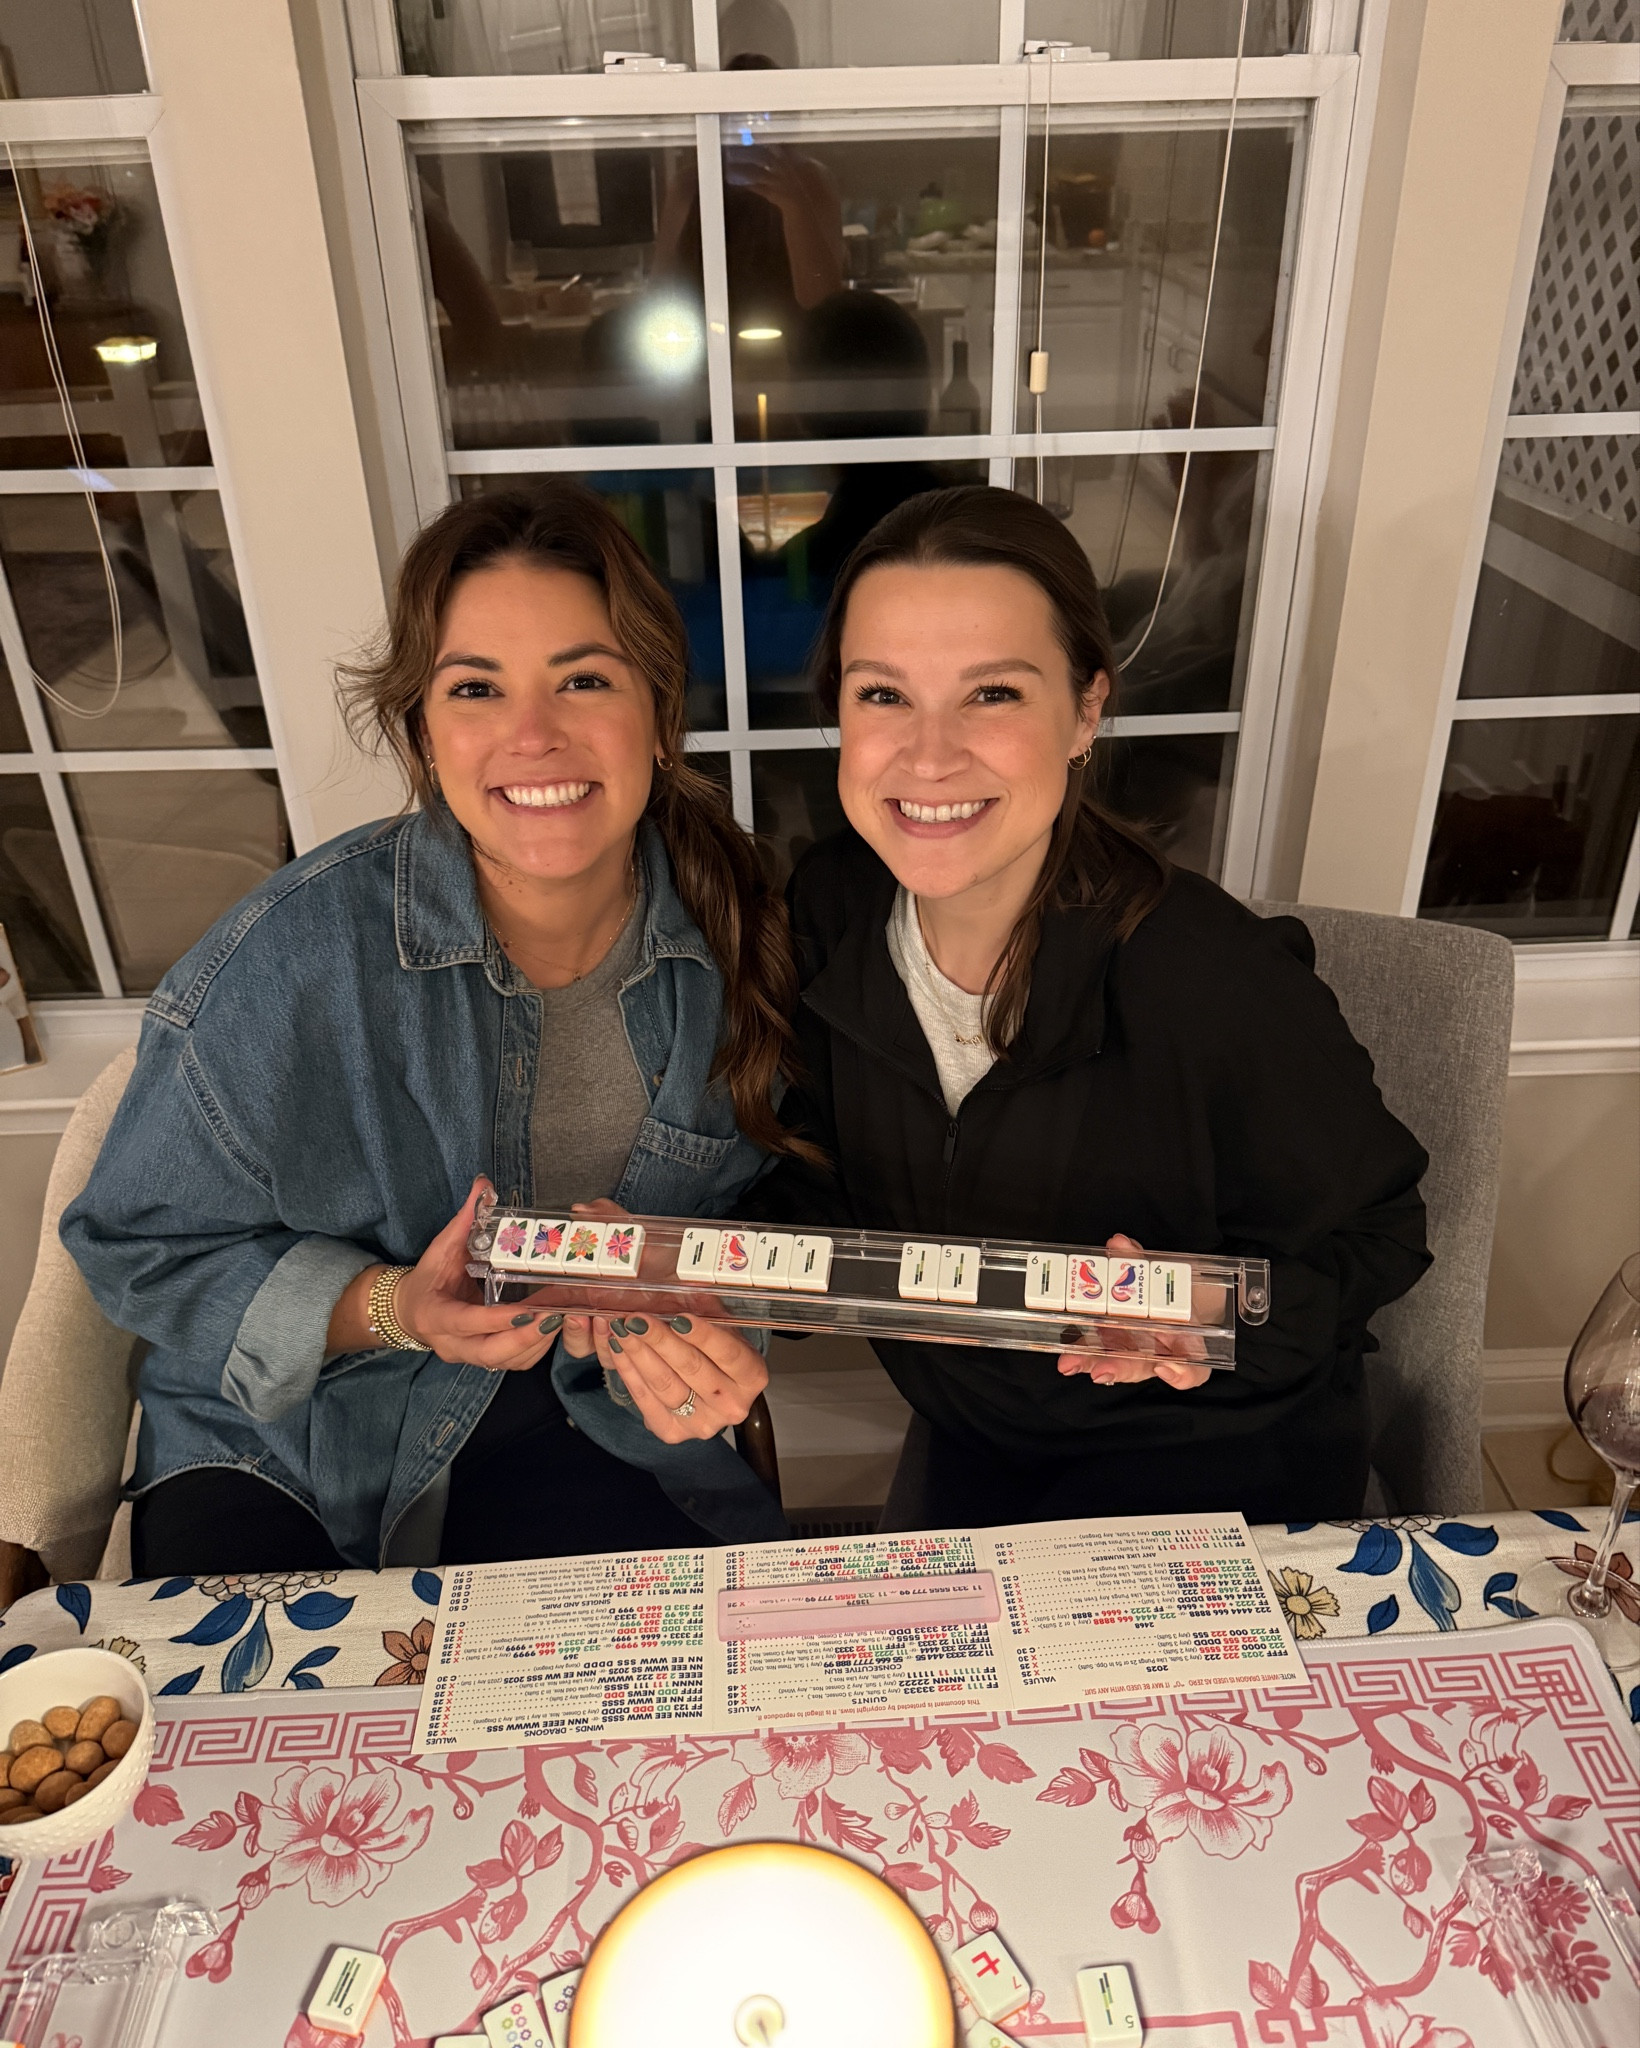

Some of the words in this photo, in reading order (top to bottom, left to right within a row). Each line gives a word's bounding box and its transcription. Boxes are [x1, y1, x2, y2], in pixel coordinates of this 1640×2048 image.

[687, 1232, 693, 1240] 4
[760, 1236, 766, 1244] 4
[797, 1239, 804, 1247] 4
[719, 1239, 727, 1266] JOKER
[906, 1246, 913, 1255] 5
[945, 1249, 952, 1257] 5
[1032, 1256, 1038, 1264] 6
[1155, 1265, 1162, 1274] 6
[581, 1598, 610, 1606] SINGLES
[846, 1598, 869, 1607] 13579
[1192, 1638, 1221, 1646] DDDD
[1258, 1634, 1282, 1642] 2025
[1198, 1645, 1221, 1653] 5555
[1264, 1649, 1288, 1657] FFFF
[1240, 1650, 1264, 1658] 2025
[844, 1663, 902, 1673] CONSECUTIVE
[1145, 1664, 1168, 1672] 2025
[898, 1678, 929, 1687] 22222
[932, 1675, 965, 1684] NNNN
[1022, 1675, 1056, 1685] VALUES
[680, 1687, 702, 1695] FFFF
[902, 1685, 935, 1694] 33333
[937, 1683, 962, 1692] 2222
[603, 1690, 624, 1699] DDD
[626, 1689, 655, 1697] NEWS
[601, 1698, 624, 1707] SSSS
[627, 1697, 653, 1705] WWW
[851, 1695, 887, 1704] QUINTS
[600, 1706, 630, 1715] DDDD
[632, 1704, 654, 1713] DDD
[727, 1704, 761, 1714] VALUES
[601, 1714, 624, 1722] SSSS
[626, 1712, 652, 1720] WWW
[674, 1710, 702, 1718] NNNN
[505, 1721, 540, 1730] WWWW
[542, 1718, 565, 1727] EEEE
[567, 1717, 588, 1725] NNN
[486, 1724, 503, 1732] SSS
[523, 1726, 566, 1737] DRAGONS
[574, 1723, 604, 1732] WINDS
[426, 1729, 438, 1737] 25
[424, 1736, 457, 1745] VALUES
[1012, 1976, 1022, 1990] 7
[1125, 2015, 1134, 2028] 5
